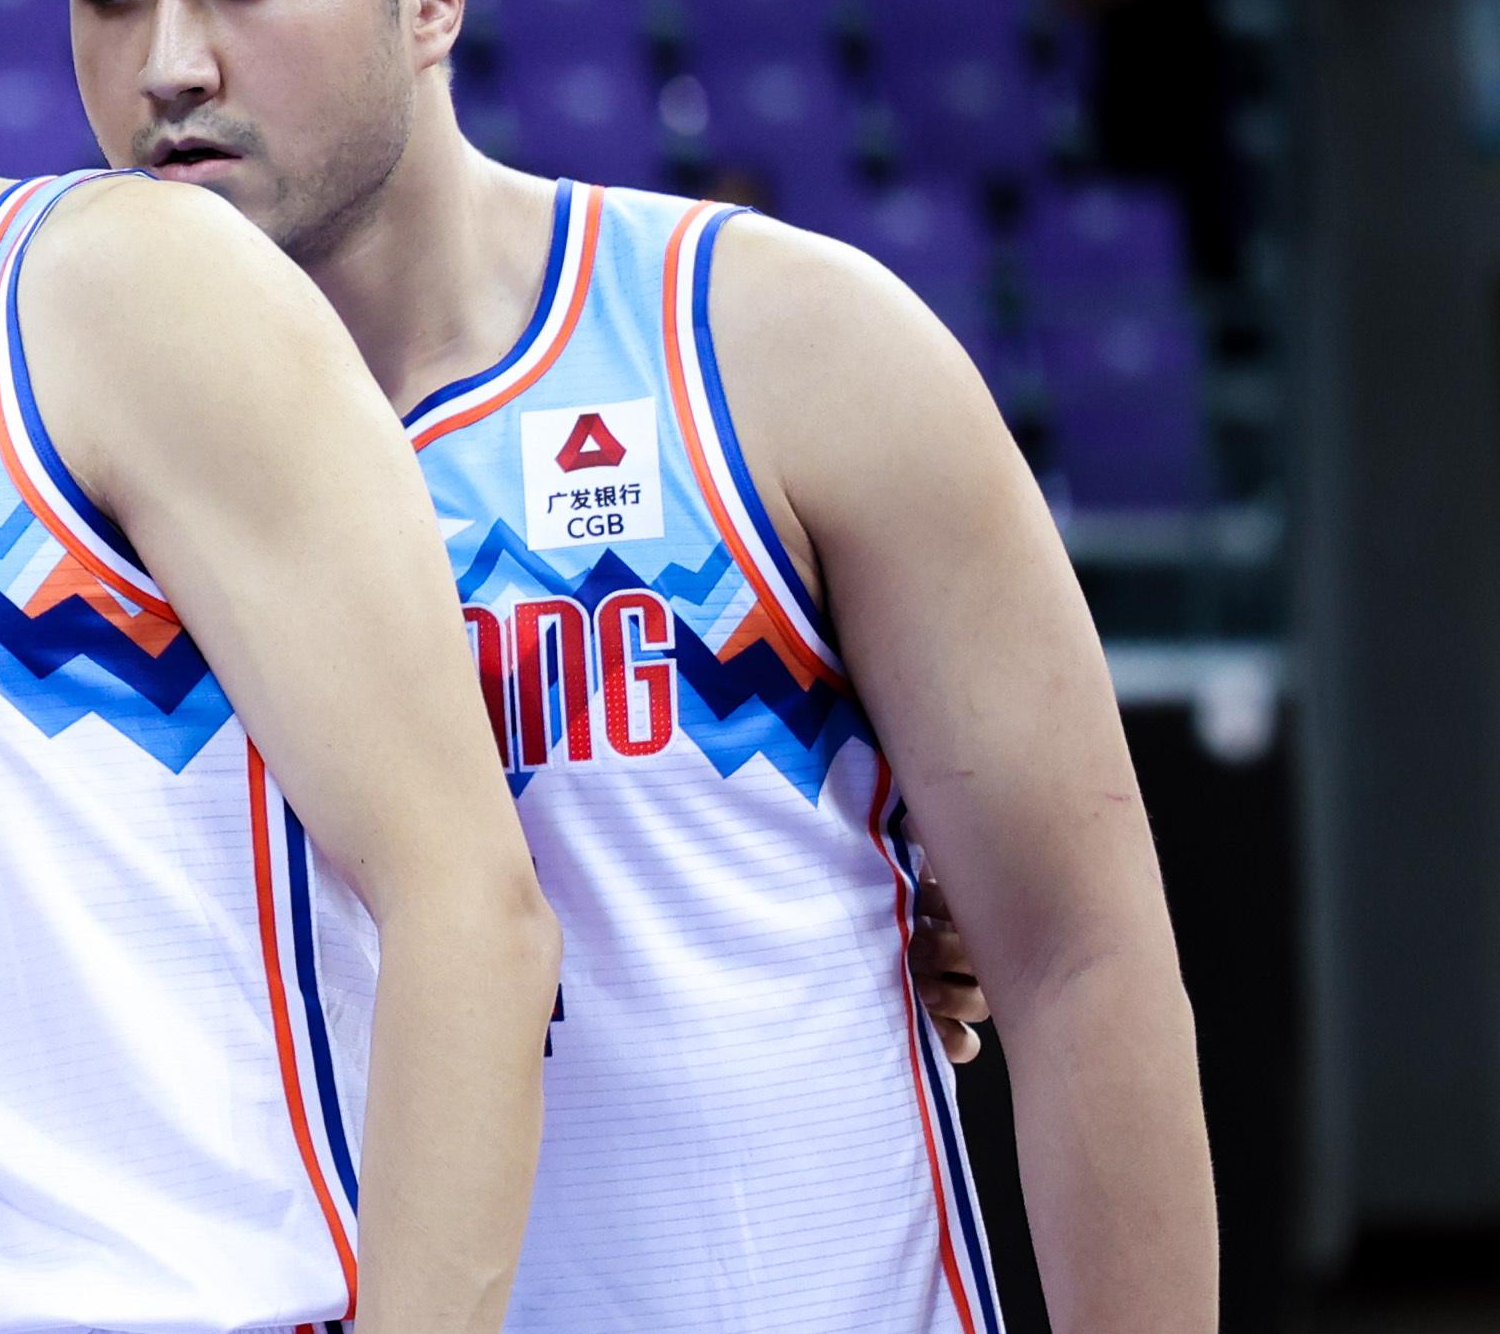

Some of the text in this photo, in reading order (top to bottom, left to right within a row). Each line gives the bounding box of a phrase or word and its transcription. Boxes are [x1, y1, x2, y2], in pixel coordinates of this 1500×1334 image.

[547, 483, 641, 514] 广发银行
[567, 513, 624, 538] CGB
